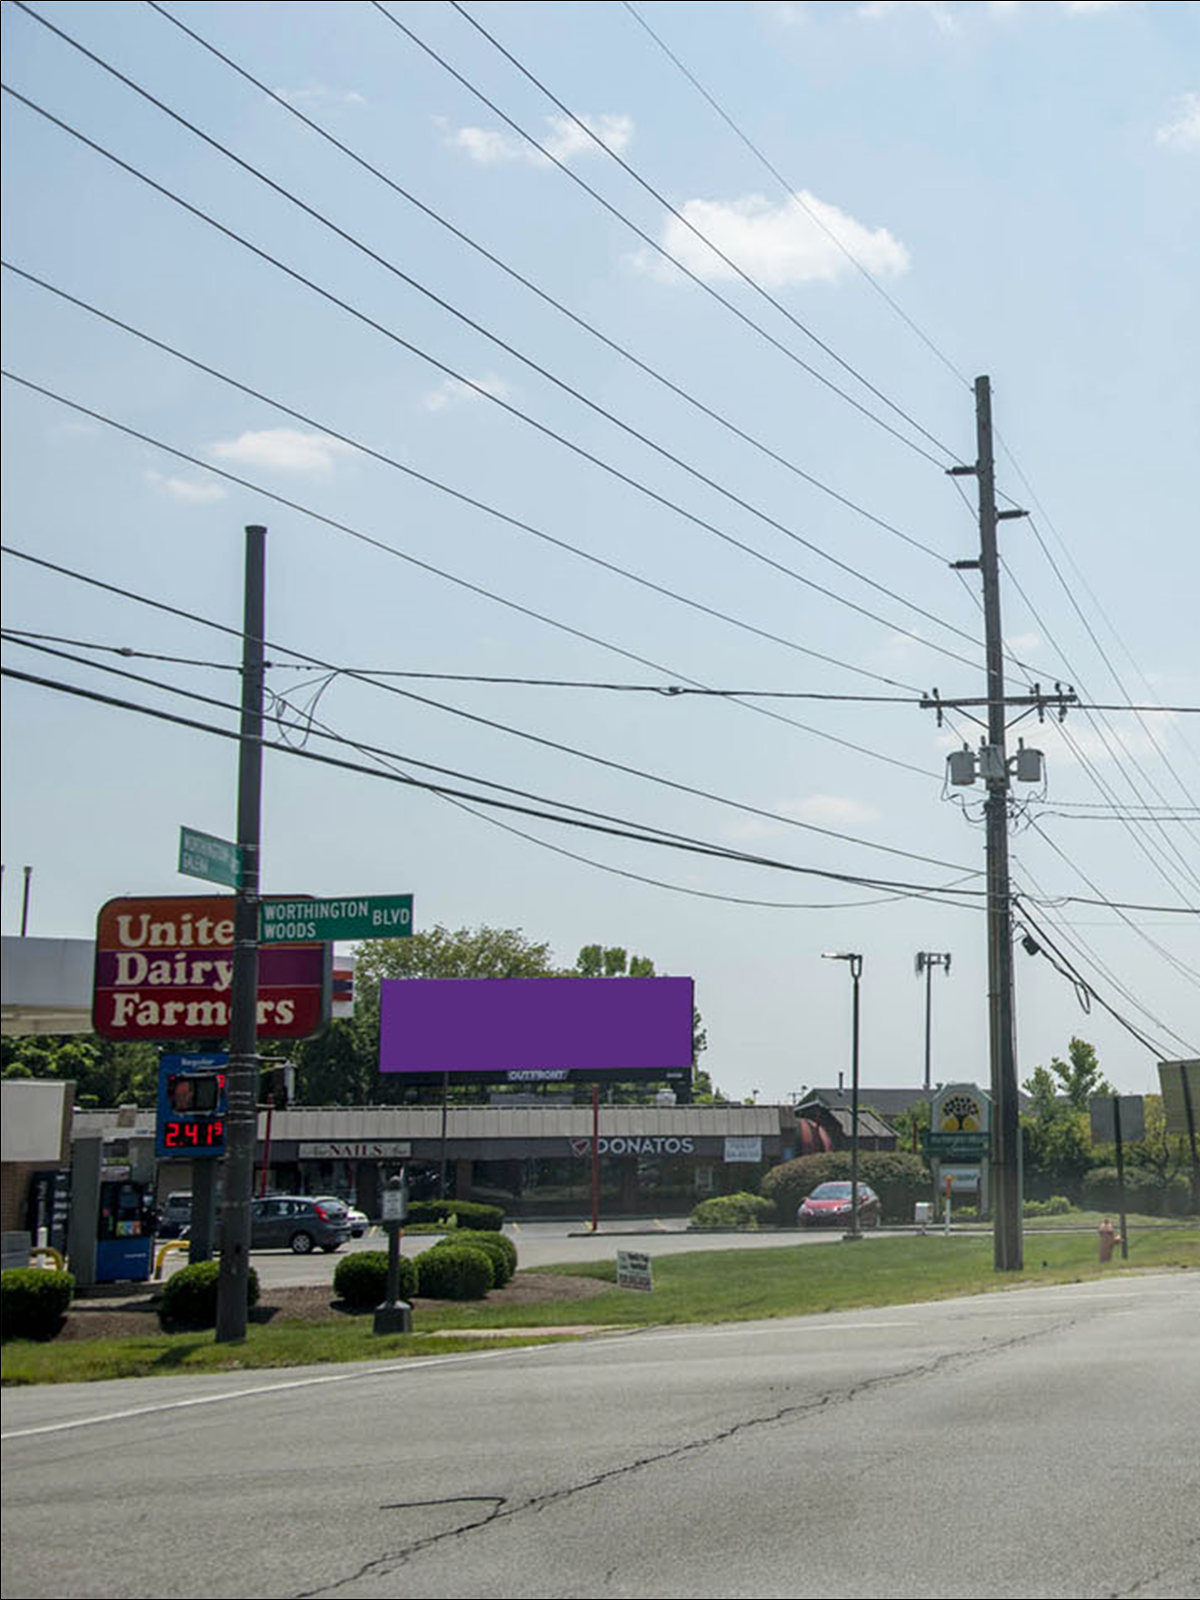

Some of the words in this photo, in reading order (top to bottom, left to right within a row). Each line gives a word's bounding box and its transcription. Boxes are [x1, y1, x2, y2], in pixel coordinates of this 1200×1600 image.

[264, 901, 369, 921] WORTHINGTON
[372, 908, 410, 926] BLVD
[117, 914, 235, 947] Unite
[265, 922, 317, 939] WOODS
[115, 952, 234, 991] Dairy
[111, 992, 296, 1026] Farmrs
[508, 1070, 564, 1081] OUTFRONT
[329, 1144, 383, 1157] NAILS
[596, 1137, 694, 1154] DONATOS
